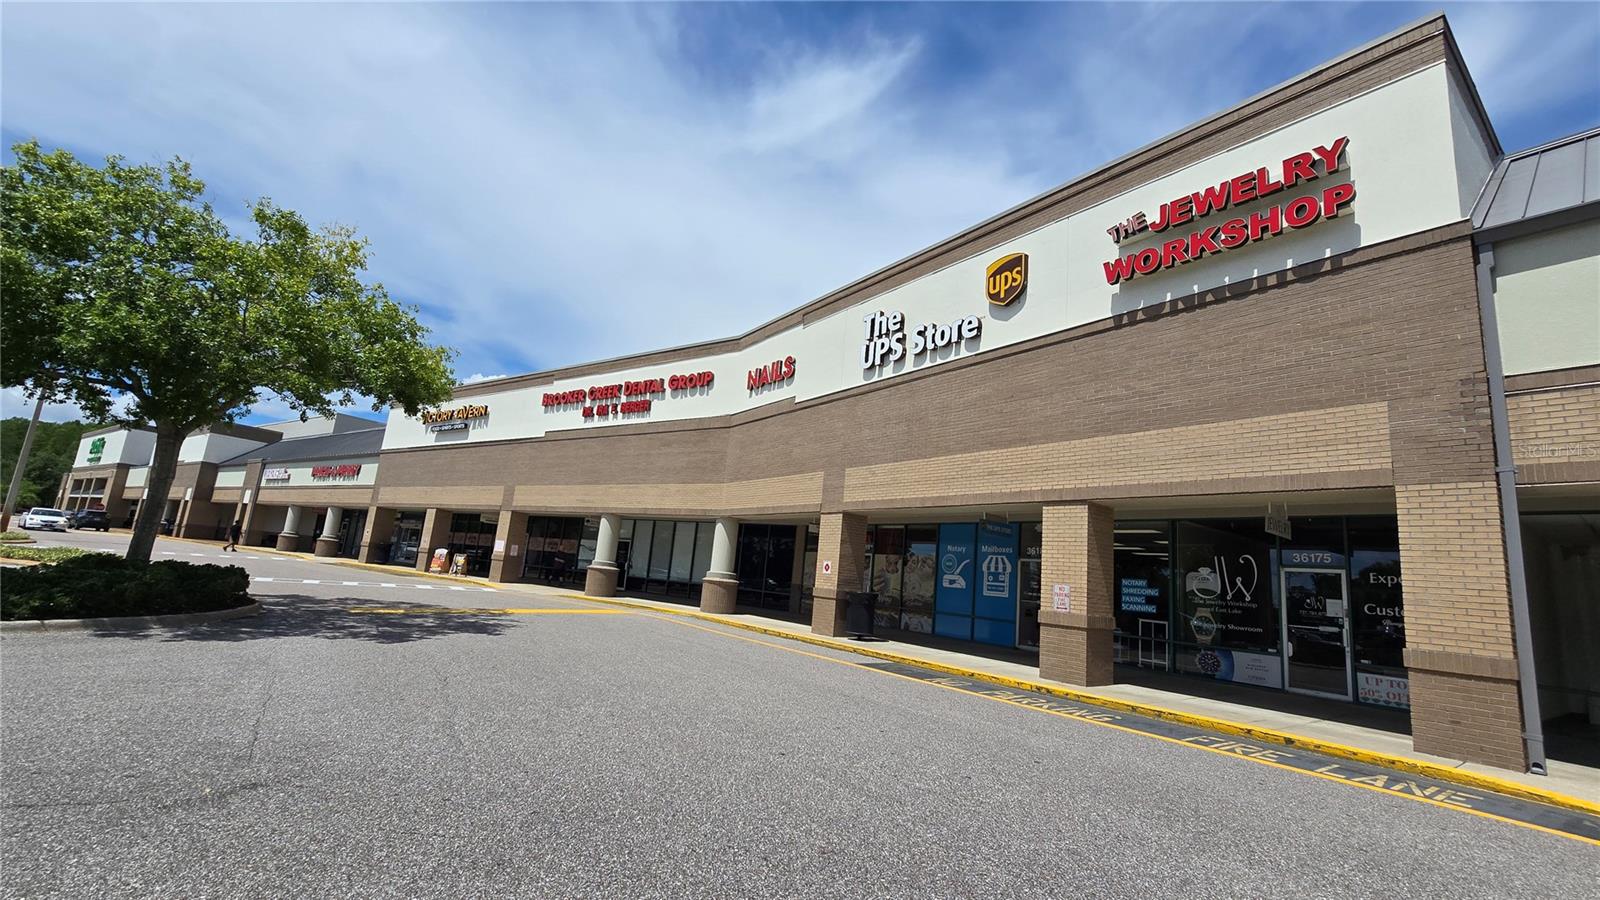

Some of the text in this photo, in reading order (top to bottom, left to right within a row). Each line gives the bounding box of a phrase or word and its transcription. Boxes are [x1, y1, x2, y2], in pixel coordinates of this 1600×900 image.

[1106, 136, 1351, 243] THE JEWELRY
[1102, 183, 1357, 286] WORKSHOP
[863, 310, 906, 340] The
[861, 314, 983, 369] UPS Store
[746, 355, 796, 392] NAILS
[541, 371, 715, 407] BROOKER CREEK DENTAL GROUP
[620, 400, 651, 414] BERGER
[422, 409, 452, 424] ICTORY
[947, 544, 967, 553] Notary
[981, 545, 1013, 553] Mailboxes
[1026, 547, 1041, 555] 361
[1292, 553, 1332, 563] 36175
[1121, 578, 1147, 587] NOTARY
[1121, 587, 1159, 596] SHREDDING
[1121, 595, 1146, 604] FAXING
[1227, 599, 1258, 608] Workshop
[1121, 603, 1157, 613] SCANNING
[1227, 623, 1263, 633] Showroom
[1365, 676, 1407, 690] UP TO
[1386, 691, 1409, 701] OF
[1182, 734, 1296, 763] FIRE
[1313, 764, 1484, 808] LANE
